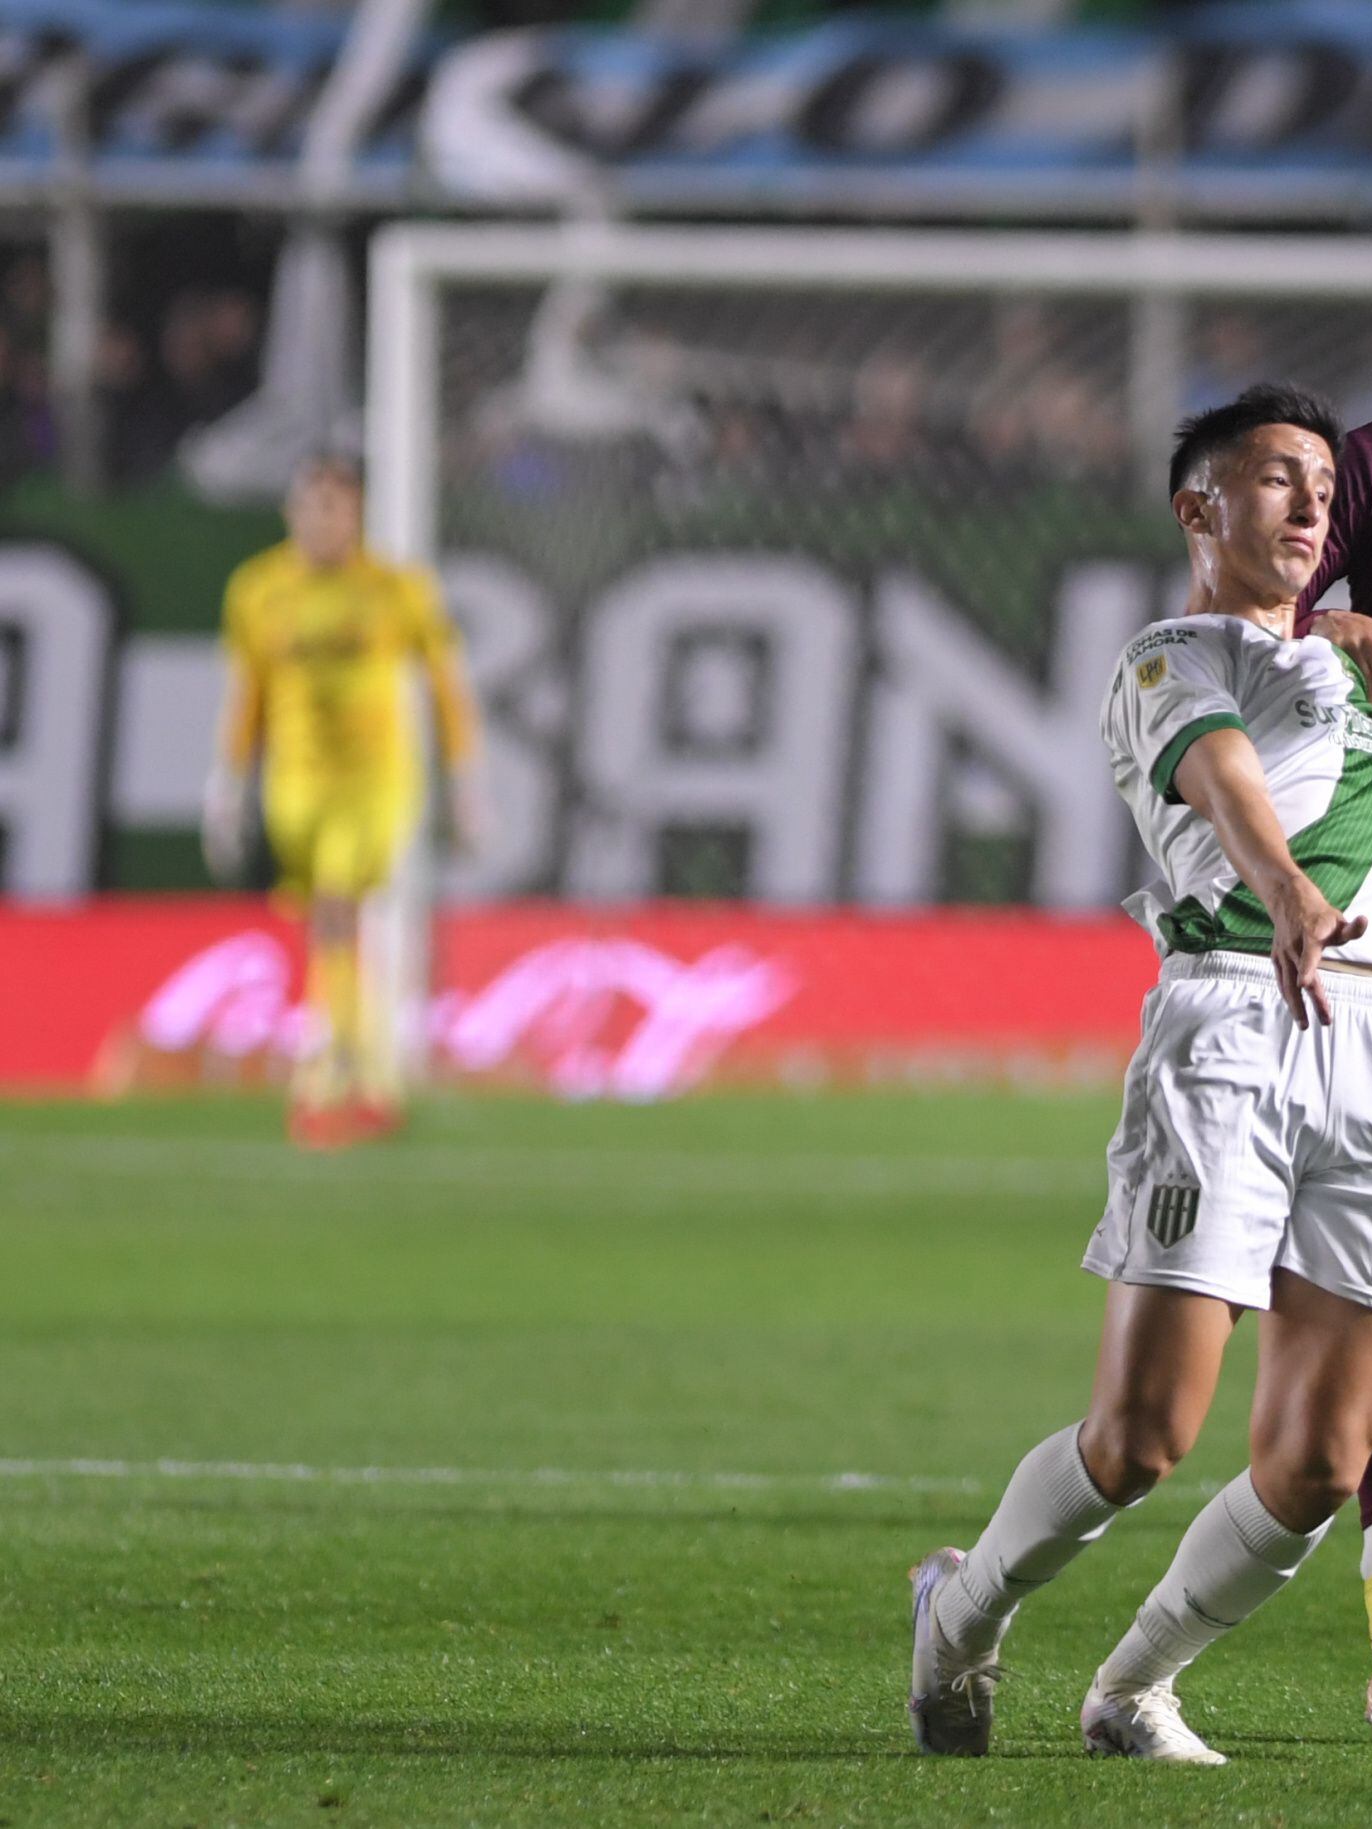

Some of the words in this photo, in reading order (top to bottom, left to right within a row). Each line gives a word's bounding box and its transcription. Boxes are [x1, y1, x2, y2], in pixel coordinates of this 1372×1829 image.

[1176, 629, 1198, 638] DE
[1127, 637, 1188, 666] ZAMORA
[1295, 700, 1338, 728] Sur
